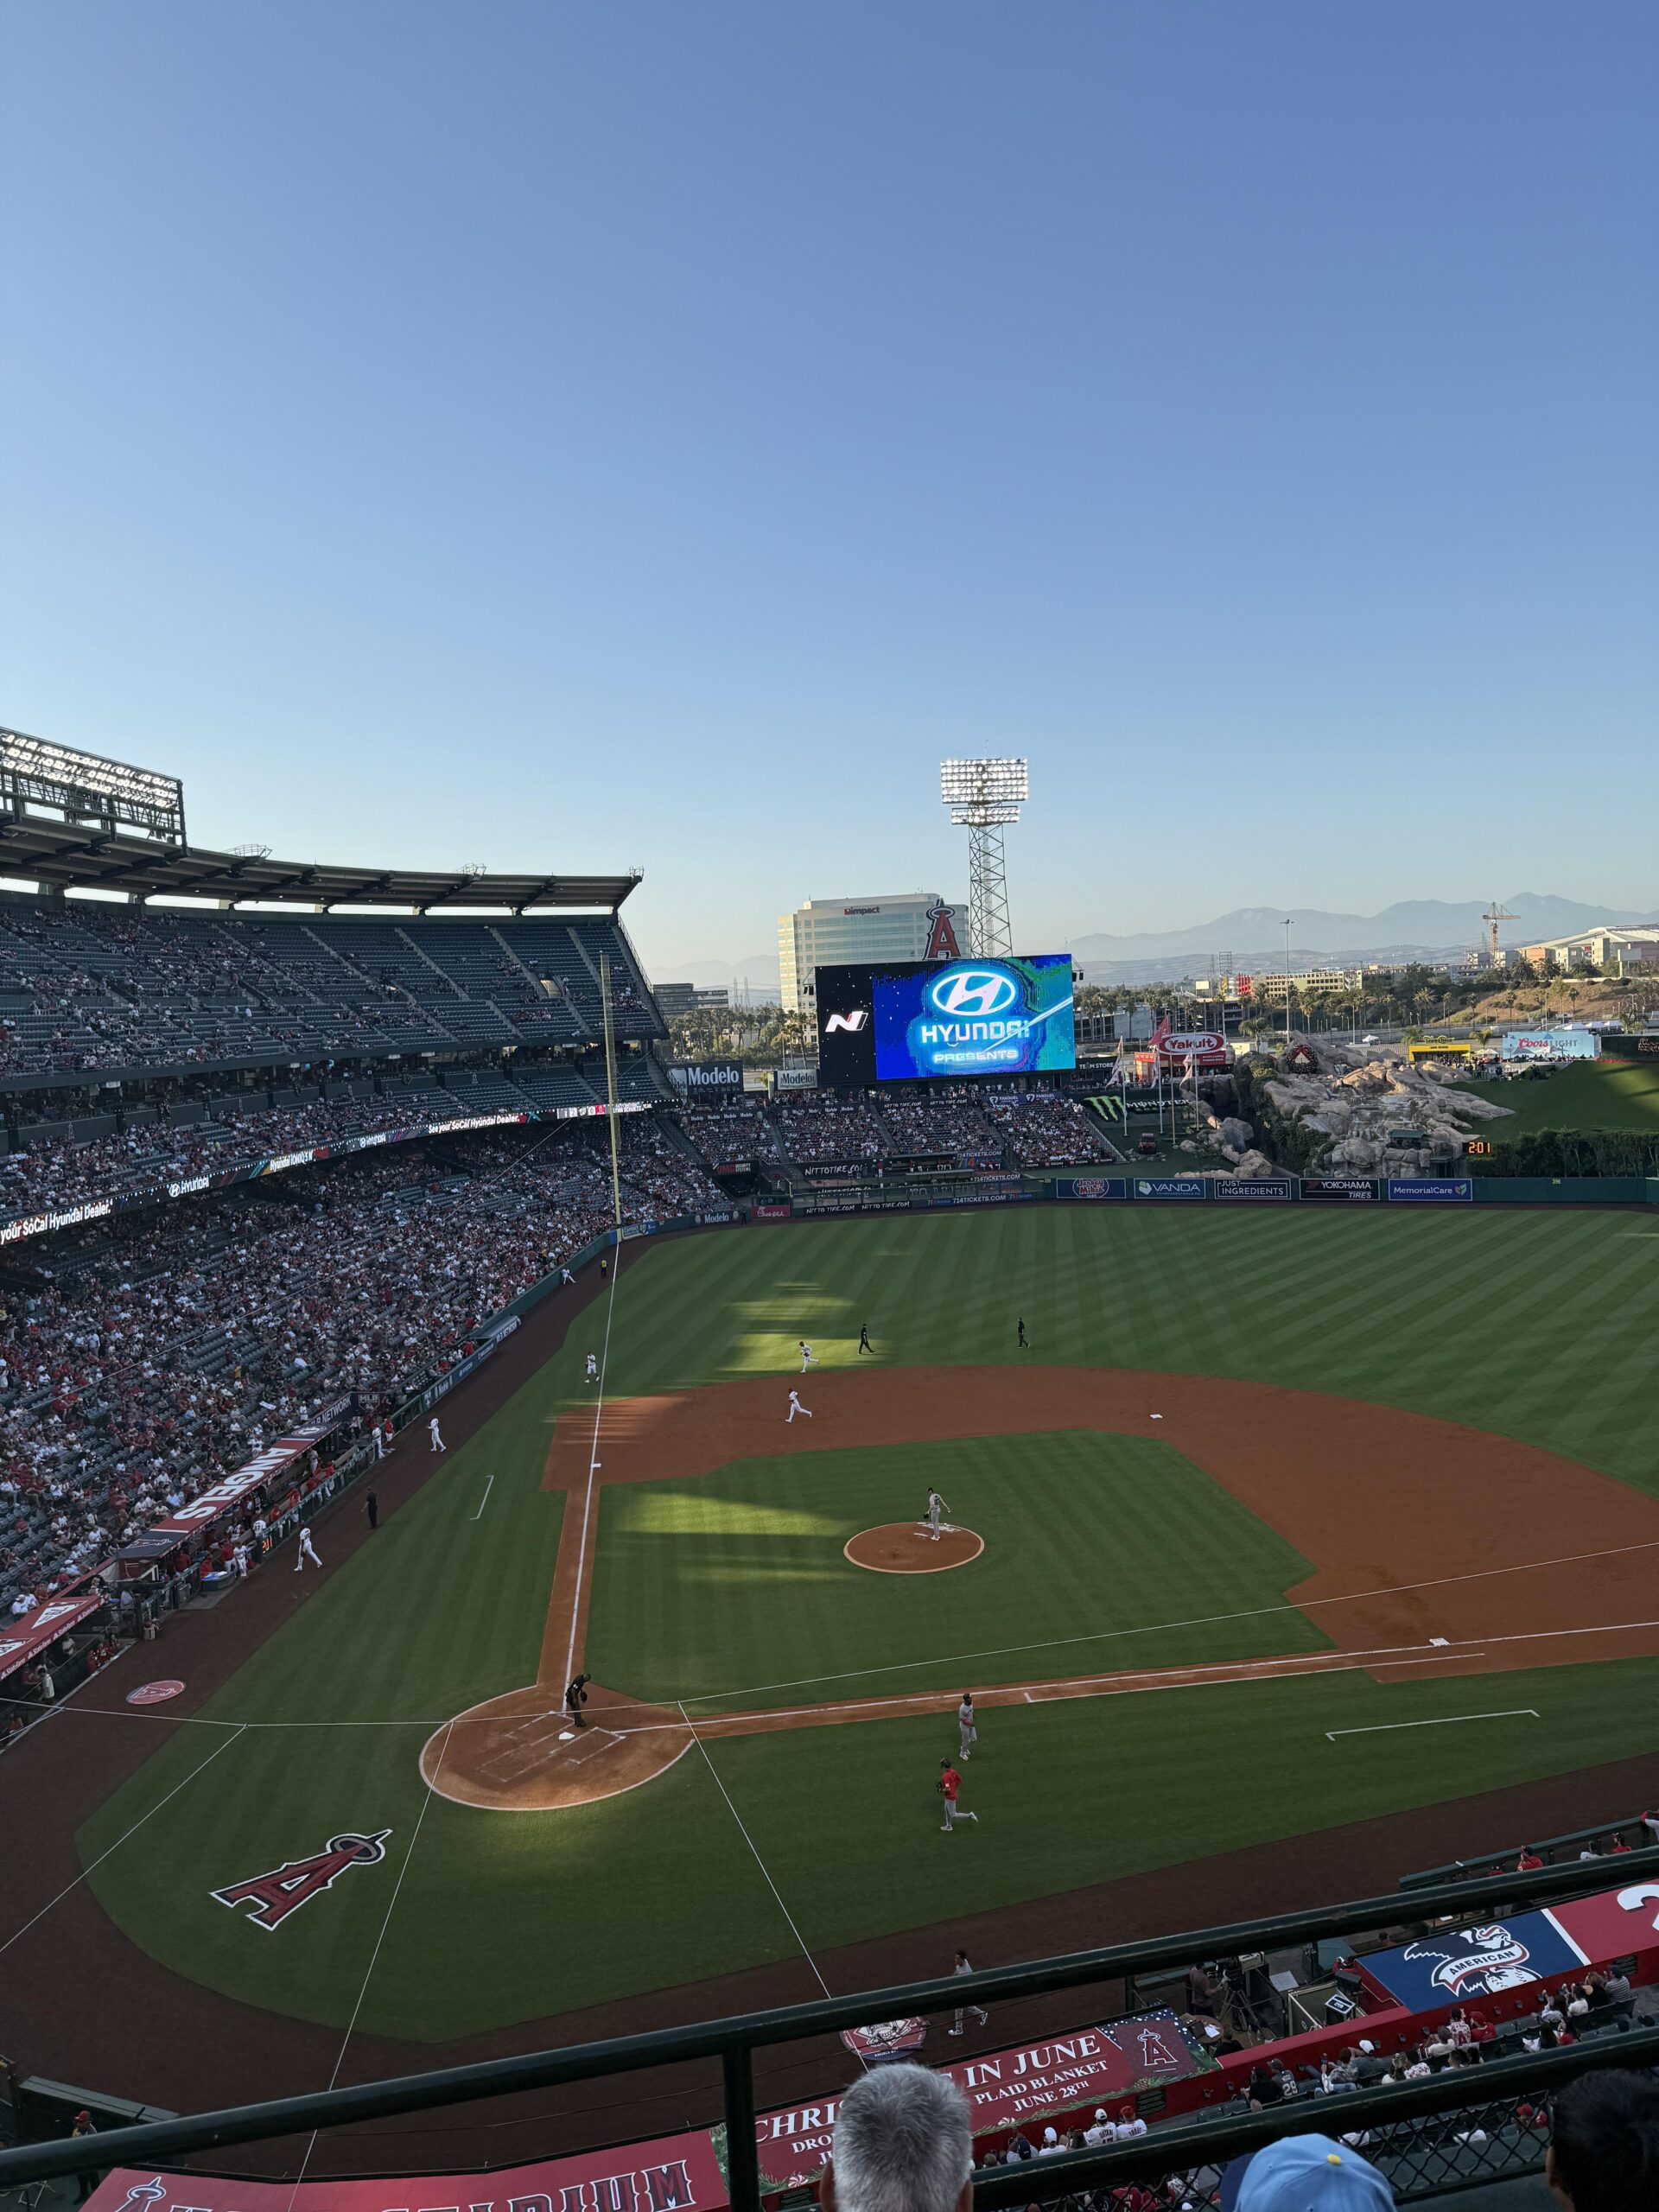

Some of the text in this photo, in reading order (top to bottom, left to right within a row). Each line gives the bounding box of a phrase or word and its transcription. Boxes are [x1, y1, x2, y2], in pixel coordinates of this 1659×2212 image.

[921, 1020, 1030, 1043] HYUNDAI
[1169, 1038, 1215, 1050] Yakult
[1518, 1037, 1549, 1049] Coors
[933, 1050, 1019, 1064] PRESENTS
[688, 1065, 740, 1086] Modelo
[781, 1071, 812, 1085] Modelo
[1125, 1099, 1192, 1108] MONSTER
[428, 1124, 439, 1135] See
[438, 1122, 451, 1134] your
[451, 1119, 469, 1130] SoCal
[470, 1116, 495, 1128] Hyundai
[1469, 1141, 1491, 1154] 2:01
[974, 1173, 1020, 1182] 714TICKETS.COM
[180, 1177, 210, 1194] HYUNDAI
[1153, 1183, 1201, 1192] VANDA
[1321, 1180, 1372, 1190] YOKOHAMA
[1393, 1185, 1453, 1196] MemorialCare
[953, 1195, 1007, 1205] 714TICKETS.COM
[1348, 1191, 1372, 1199] TIRES
[882, 1200, 910, 1209] TIRE.COM
[704, 1212, 729, 1224] Modelo
[0, 1223, 22, 1245] your
[22, 1215, 48, 1236] SoCal
[49, 1209, 83, 1230] Hyundai
[359, 1394, 378, 1402] MLB
[322, 1395, 352, 1424] NETWORK
[173, 1447, 297, 1520] ANGELS
[1449, 1949, 1516, 1976] AMERICAN
[963, 2035, 1101, 2088] IN JUNE
[974, 2060, 1109, 2106] PLAID BLANKET
[1013, 2089, 1058, 2113] JUNE
